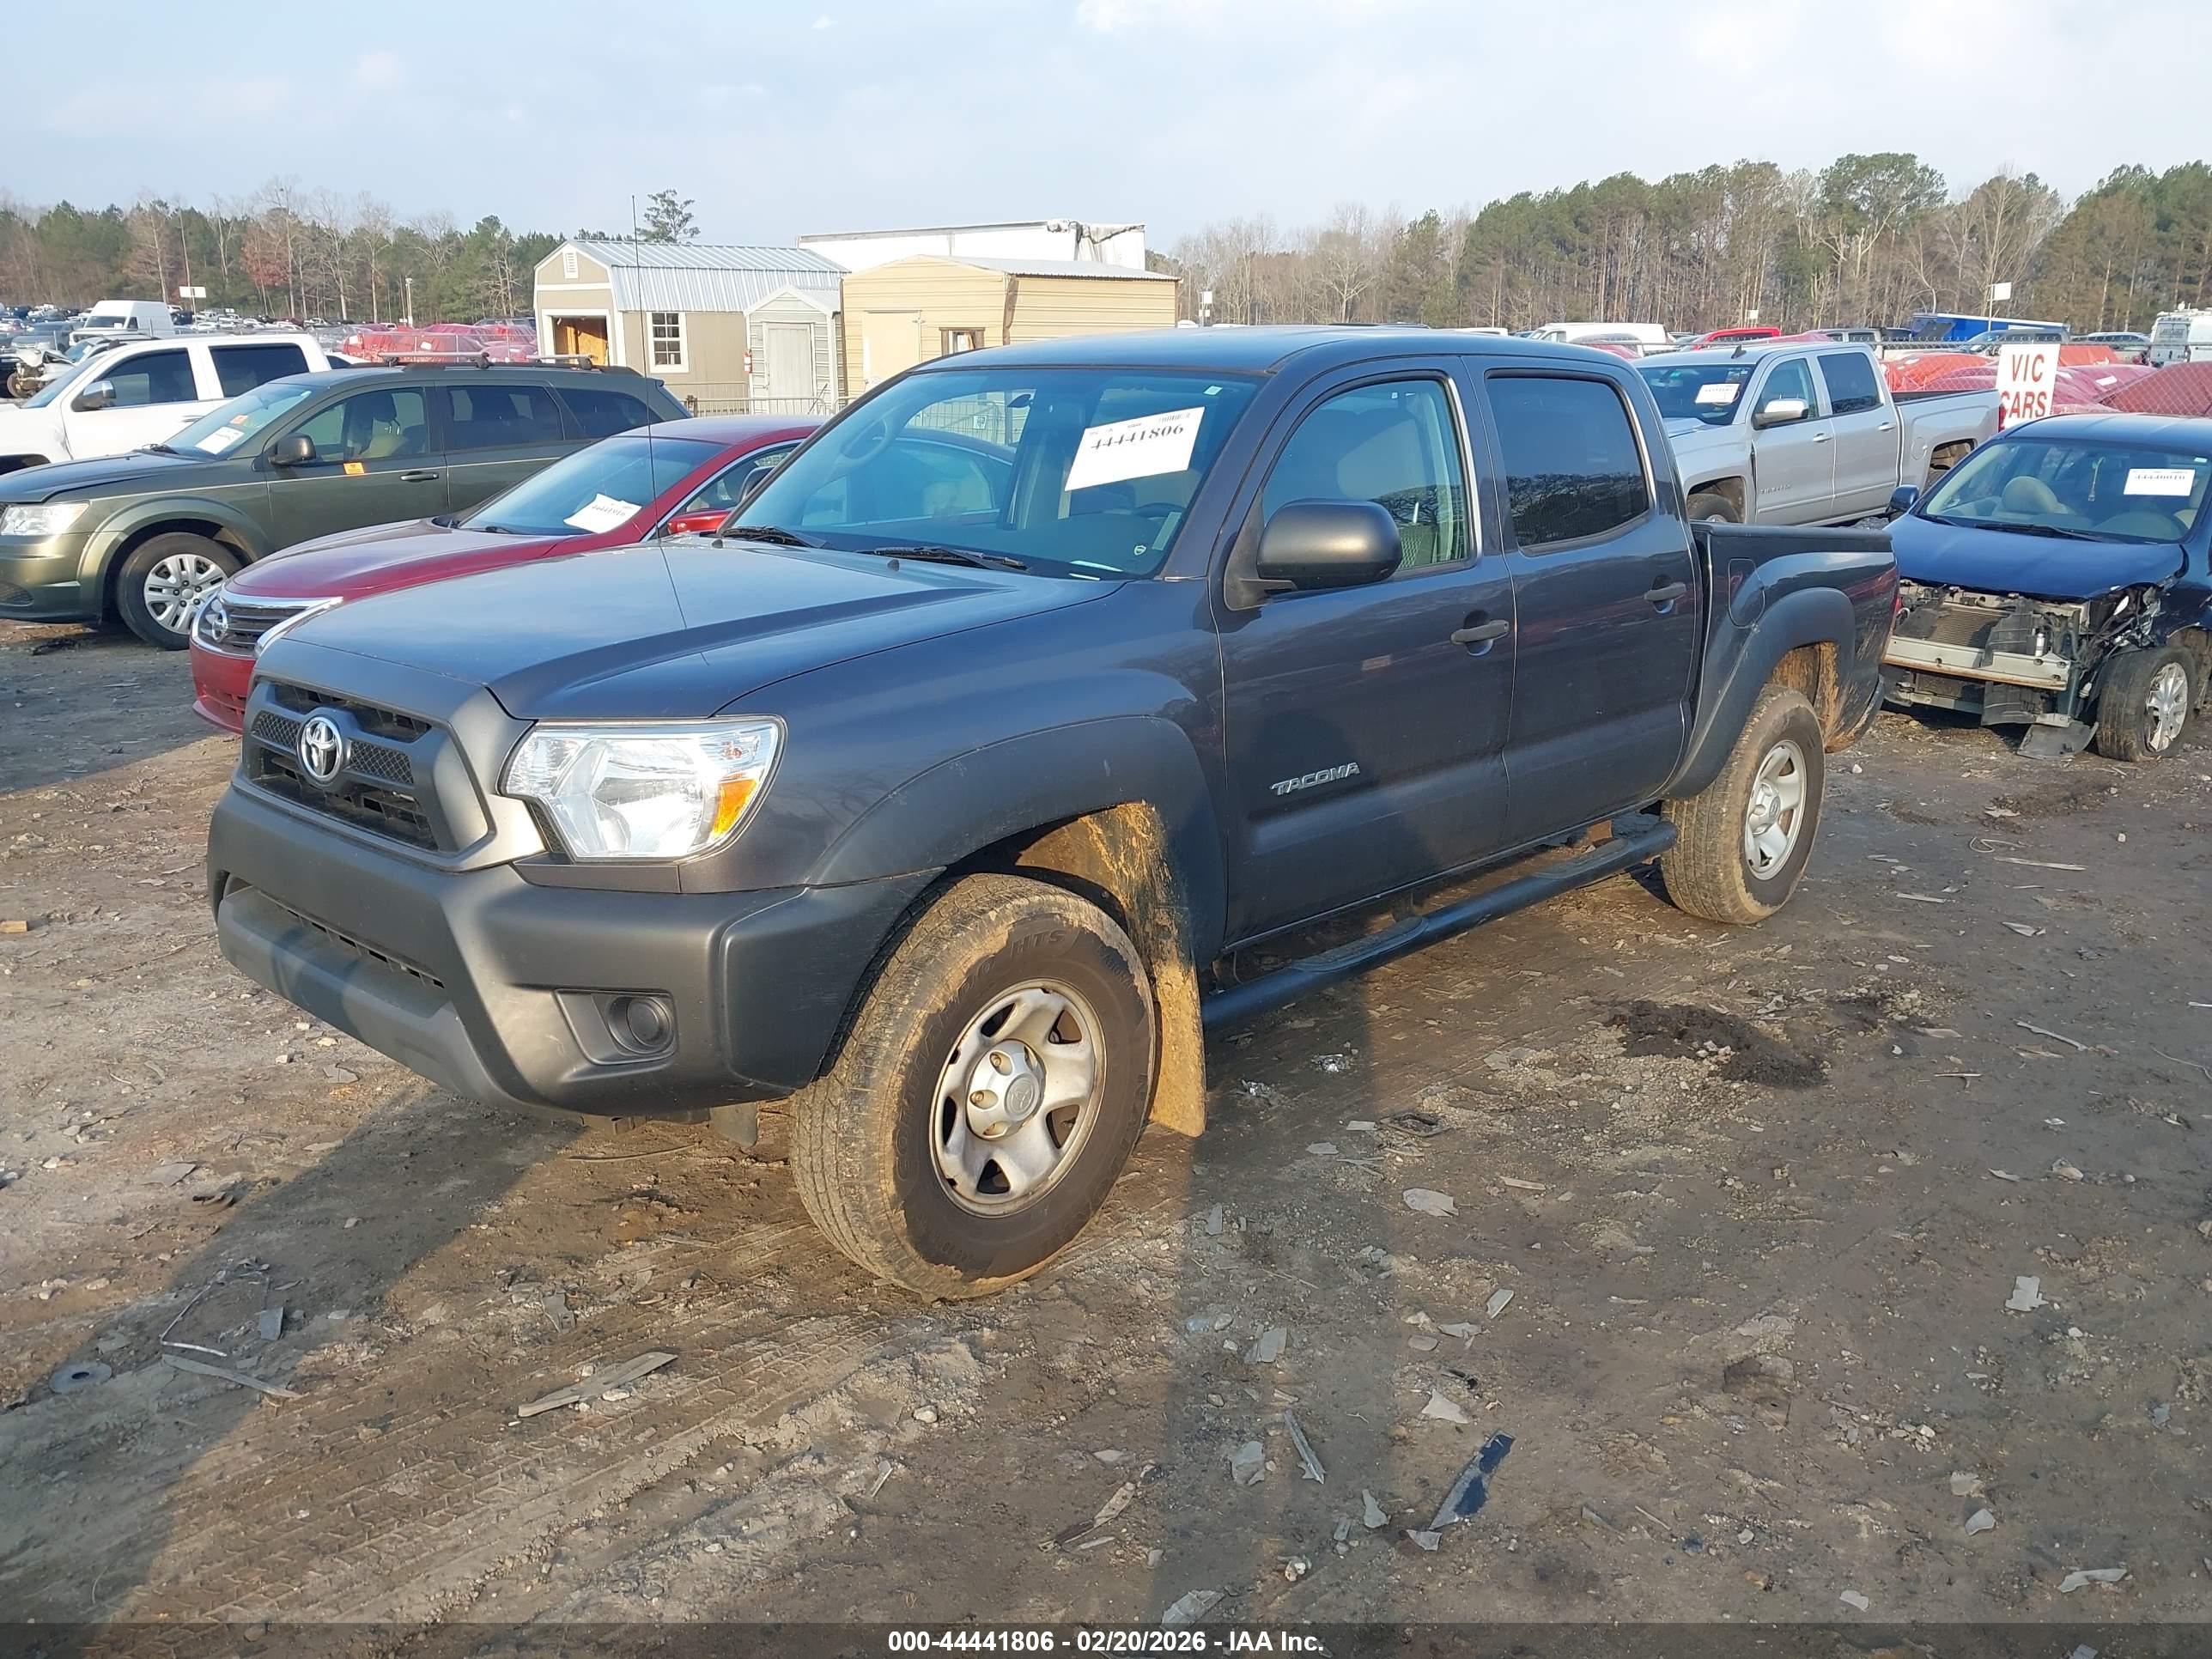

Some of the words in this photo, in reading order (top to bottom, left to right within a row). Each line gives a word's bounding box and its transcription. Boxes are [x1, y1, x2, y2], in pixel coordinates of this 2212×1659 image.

[2012, 354, 2045, 382] VIC
[1091, 424, 1184, 450] 44441806
[1270, 762, 1360, 795] TACOMA
[1011, 928, 1066, 958] HTS
